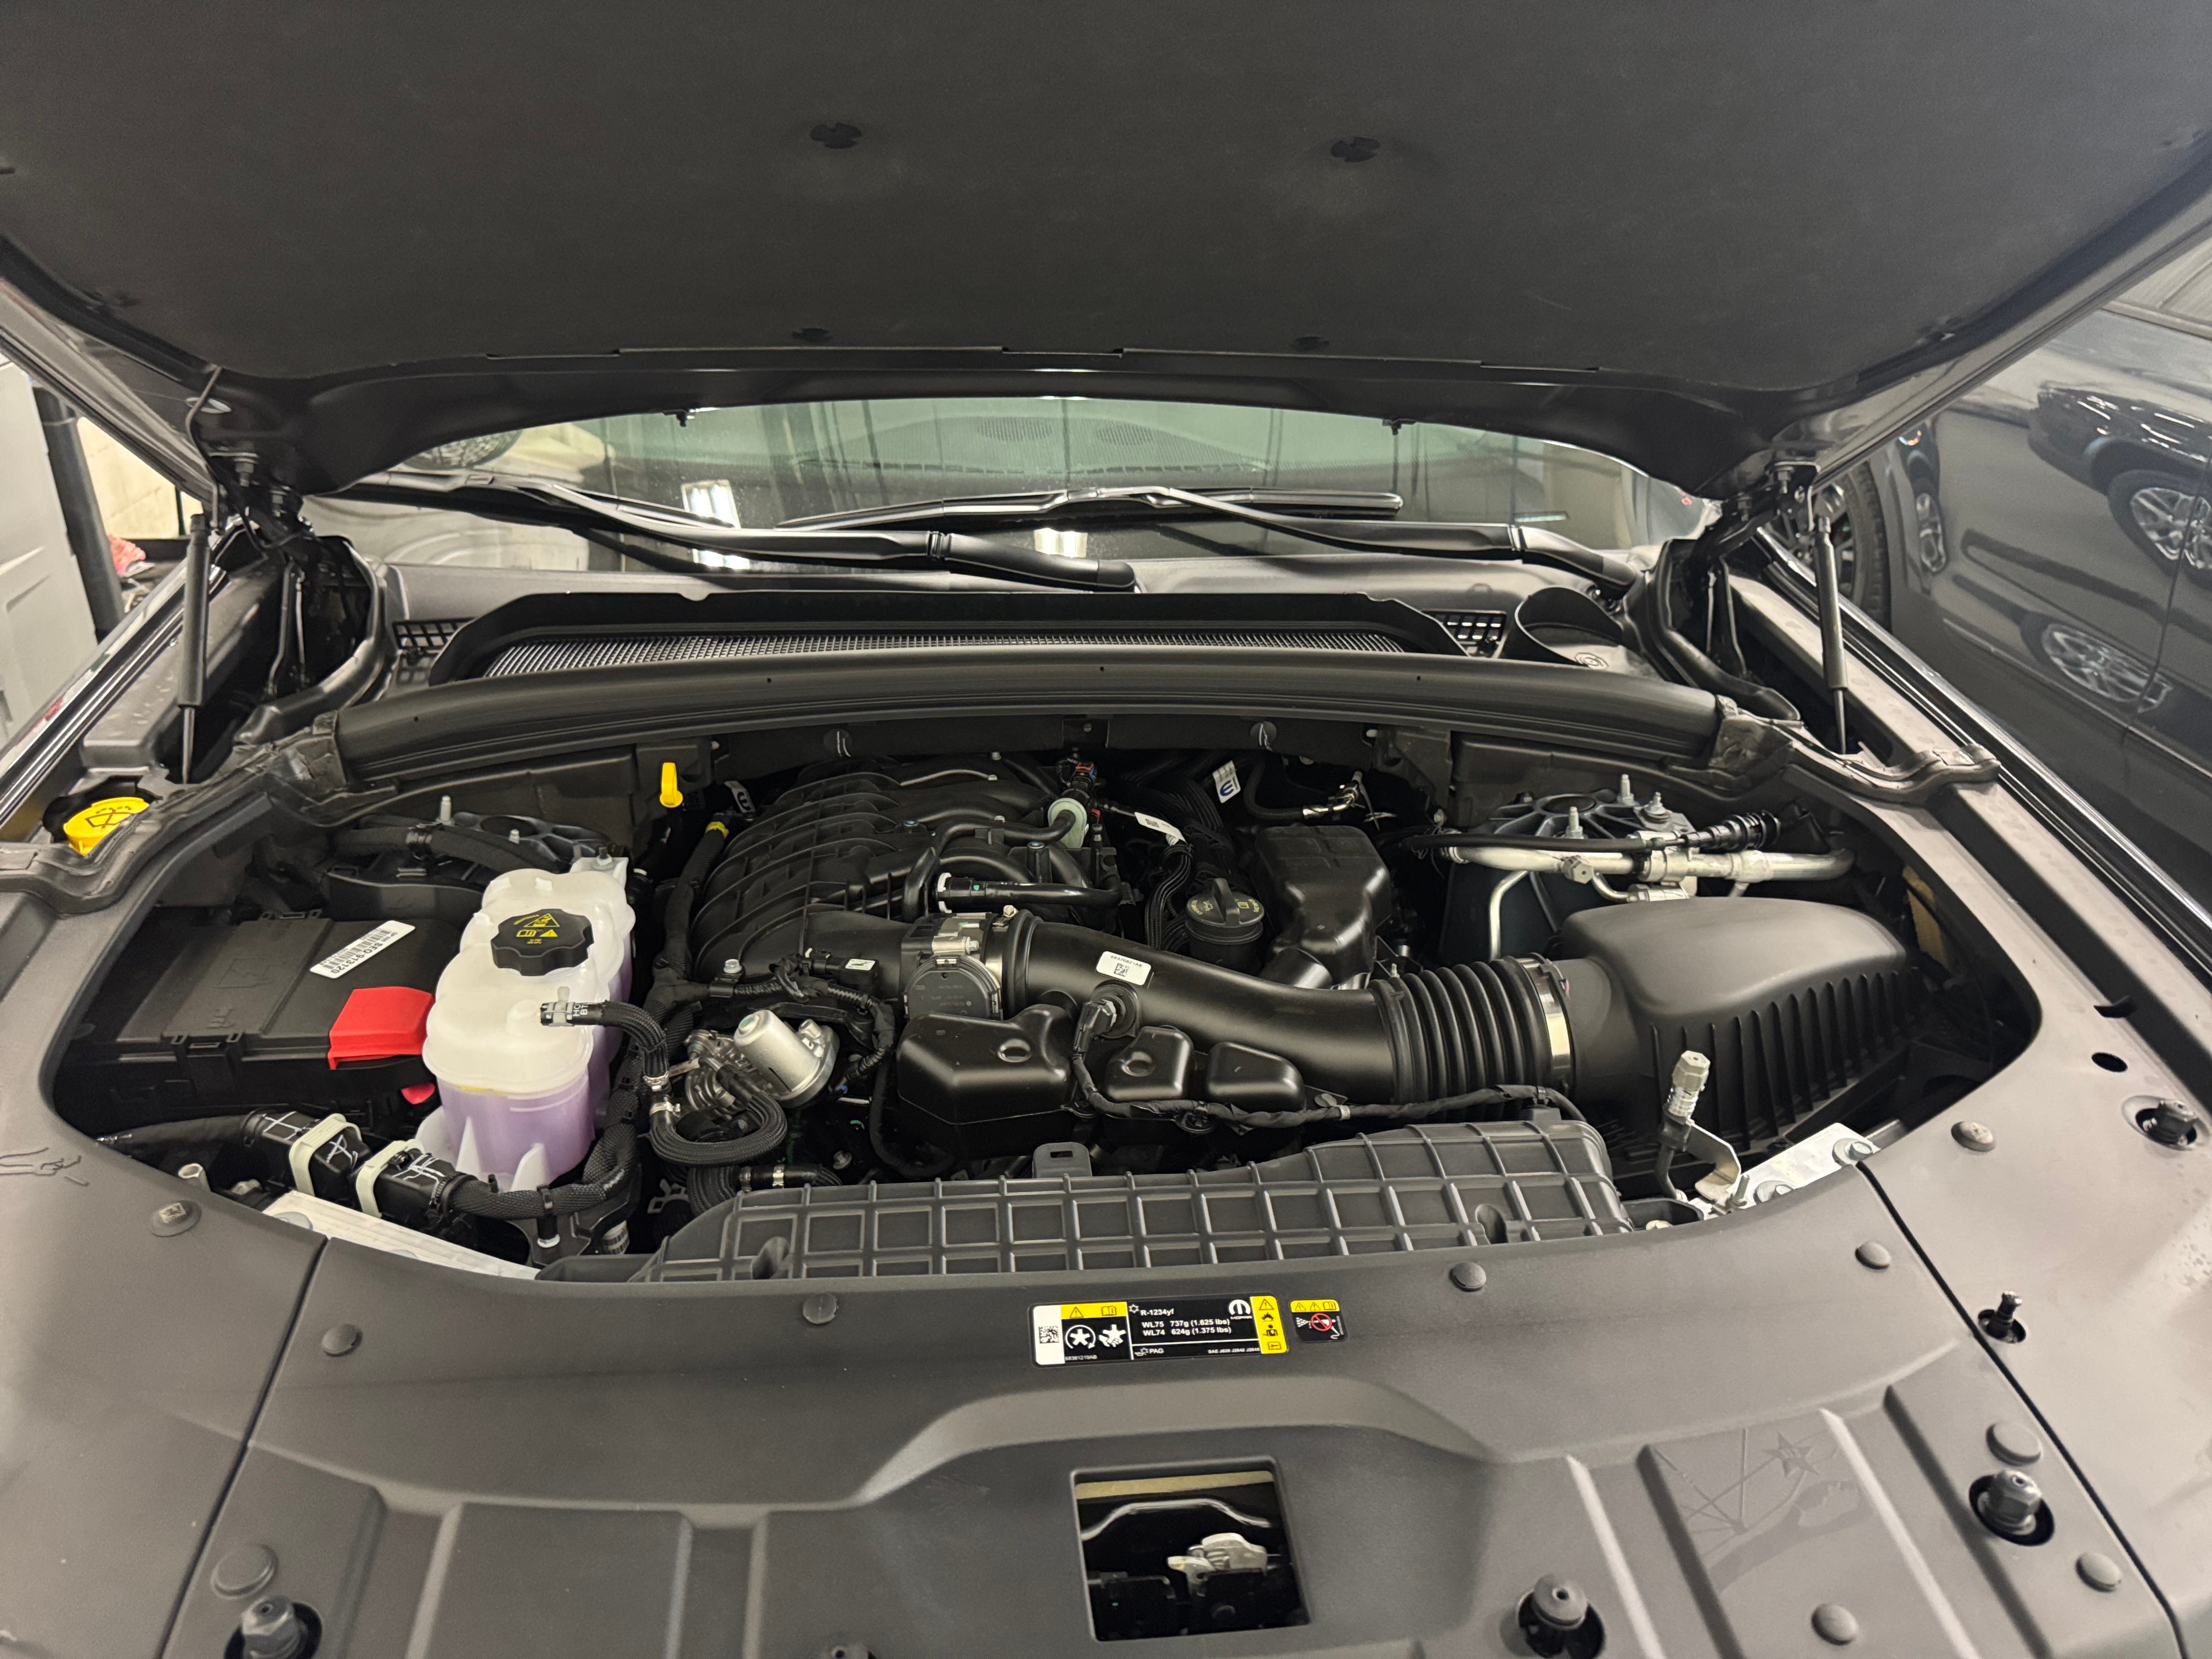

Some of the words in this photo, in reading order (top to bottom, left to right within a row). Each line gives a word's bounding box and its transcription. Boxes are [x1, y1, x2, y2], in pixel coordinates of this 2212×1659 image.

[1140, 1308, 1175, 1316] R-1234yf
[1190, 1319, 1214, 1327] (1.625
[1192, 1327, 1215, 1335] (1.375
